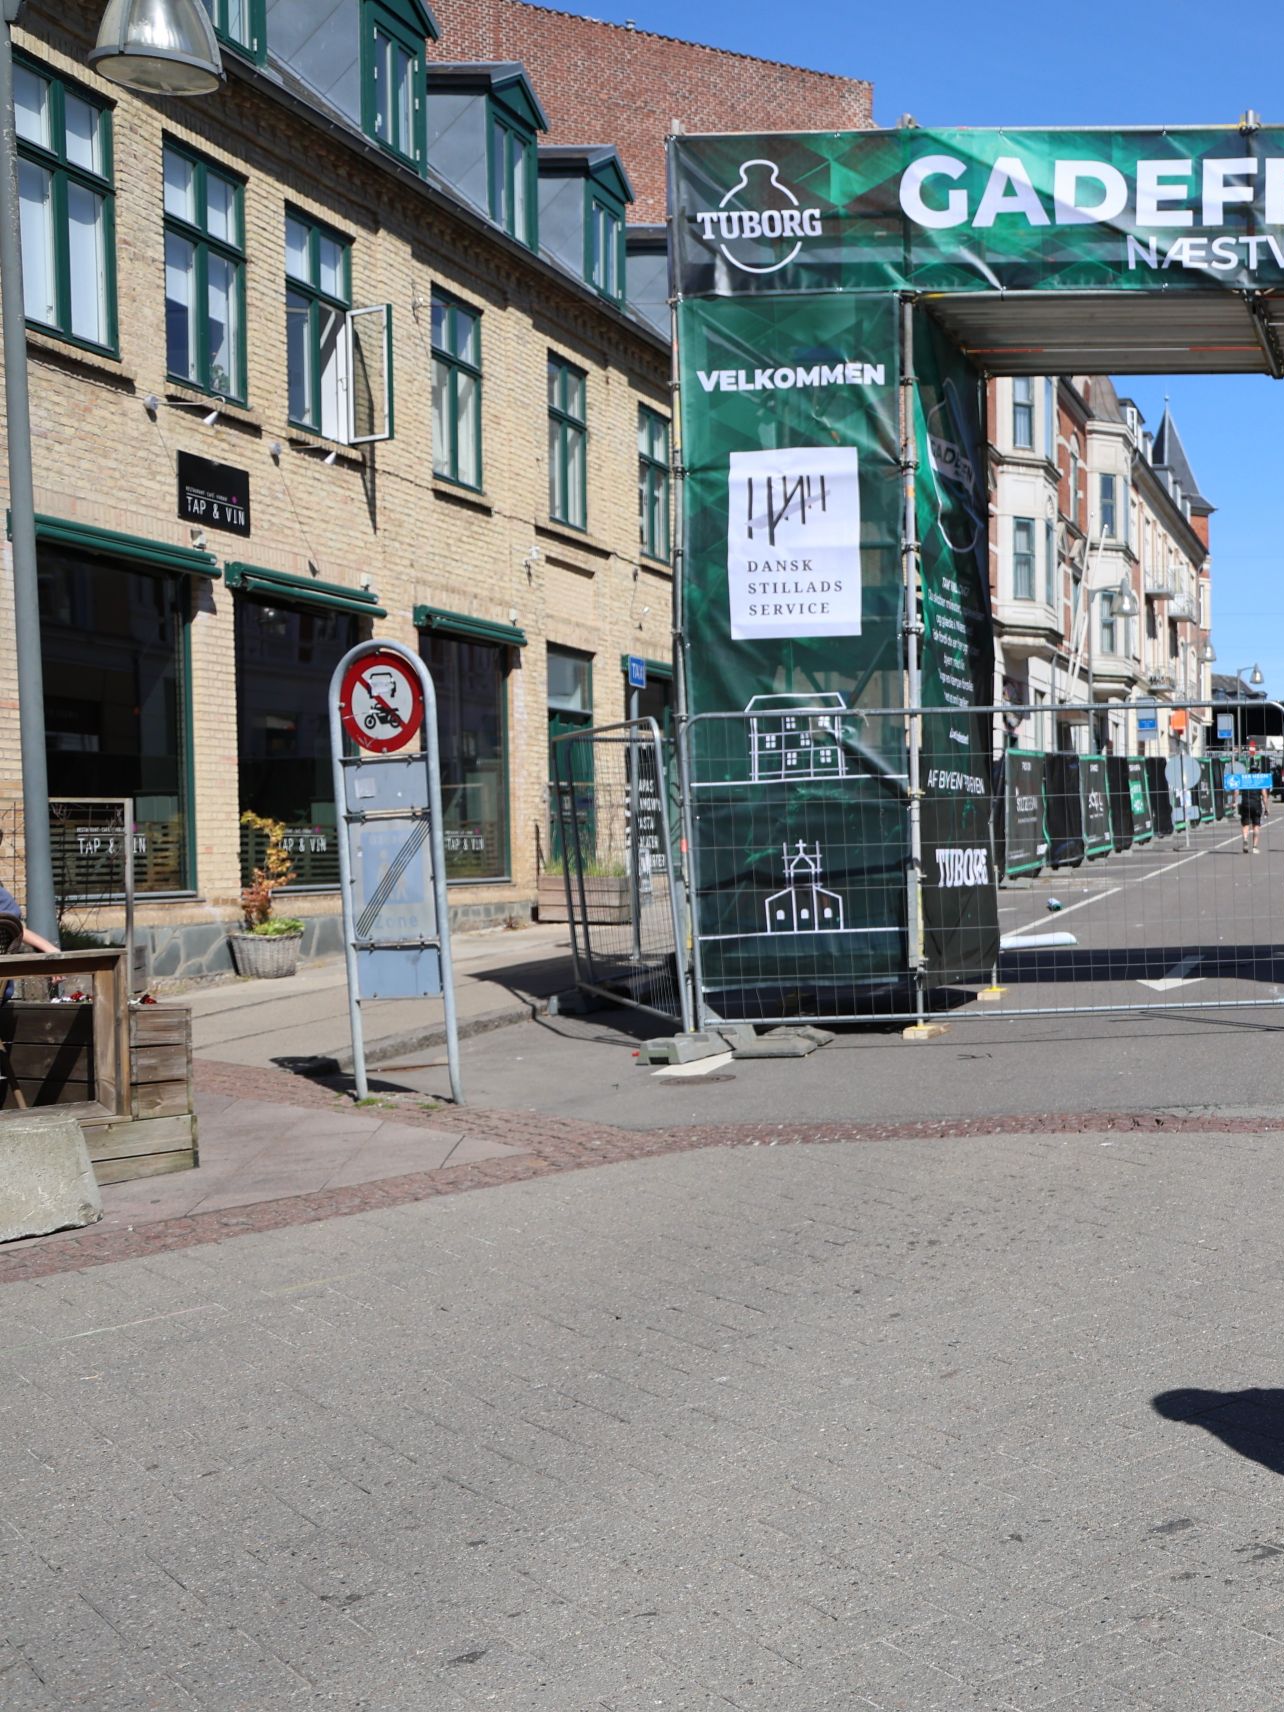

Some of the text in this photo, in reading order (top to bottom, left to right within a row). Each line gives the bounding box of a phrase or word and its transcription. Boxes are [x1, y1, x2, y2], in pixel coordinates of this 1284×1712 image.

[697, 208, 823, 240] TUBORG
[696, 362, 886, 392] VELKOMMEN
[186, 495, 245, 526] TAP & VIN
[747, 559, 813, 573] DANSK
[748, 580, 843, 595] STILLADS
[748, 602, 830, 616] SERVICE
[927, 768, 939, 788] AF
[938, 770, 963, 791] BYEN
[77, 837, 101, 855] TAP
[132, 837, 147, 854] IN
